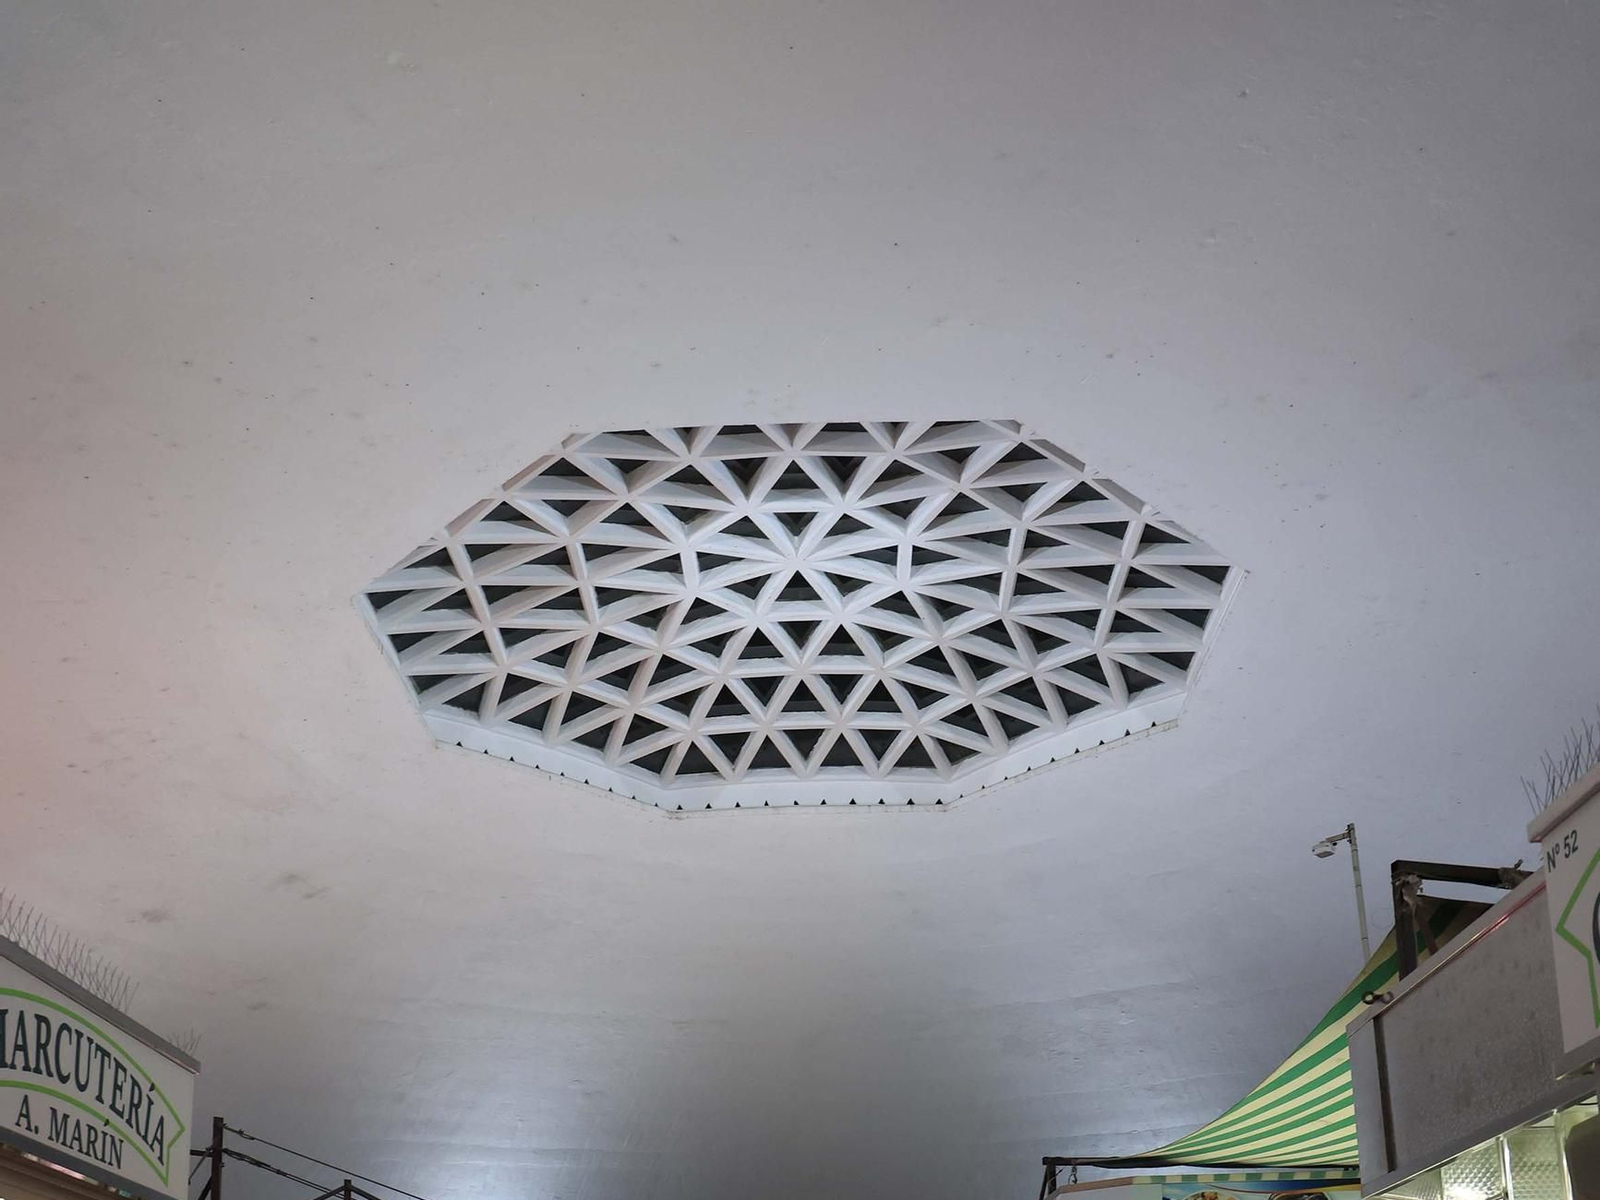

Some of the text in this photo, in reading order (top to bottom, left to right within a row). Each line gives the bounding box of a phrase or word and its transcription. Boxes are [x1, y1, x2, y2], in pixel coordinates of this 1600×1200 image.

[1564, 829, 1578, 859] 52
[15, 1094, 124, 1170] A. MARÍN
